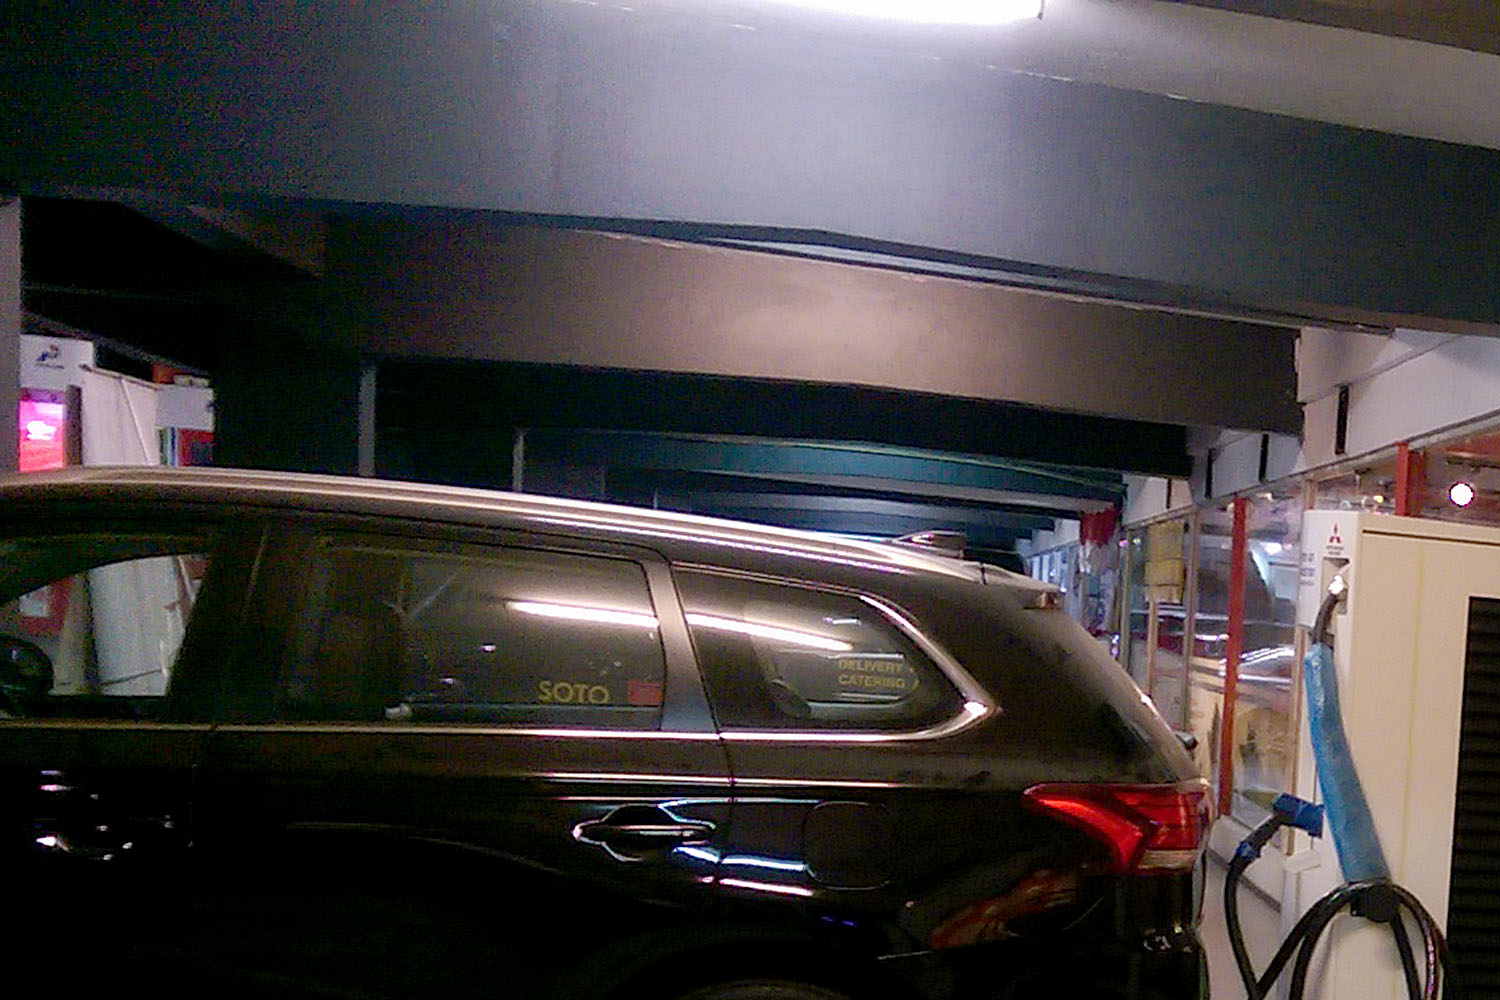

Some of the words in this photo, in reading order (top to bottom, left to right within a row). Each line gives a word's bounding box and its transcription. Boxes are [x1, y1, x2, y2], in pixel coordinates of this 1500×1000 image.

[839, 659, 905, 673] DELIVERY
[839, 674, 905, 688] CATERING
[539, 681, 609, 704] SOTO
